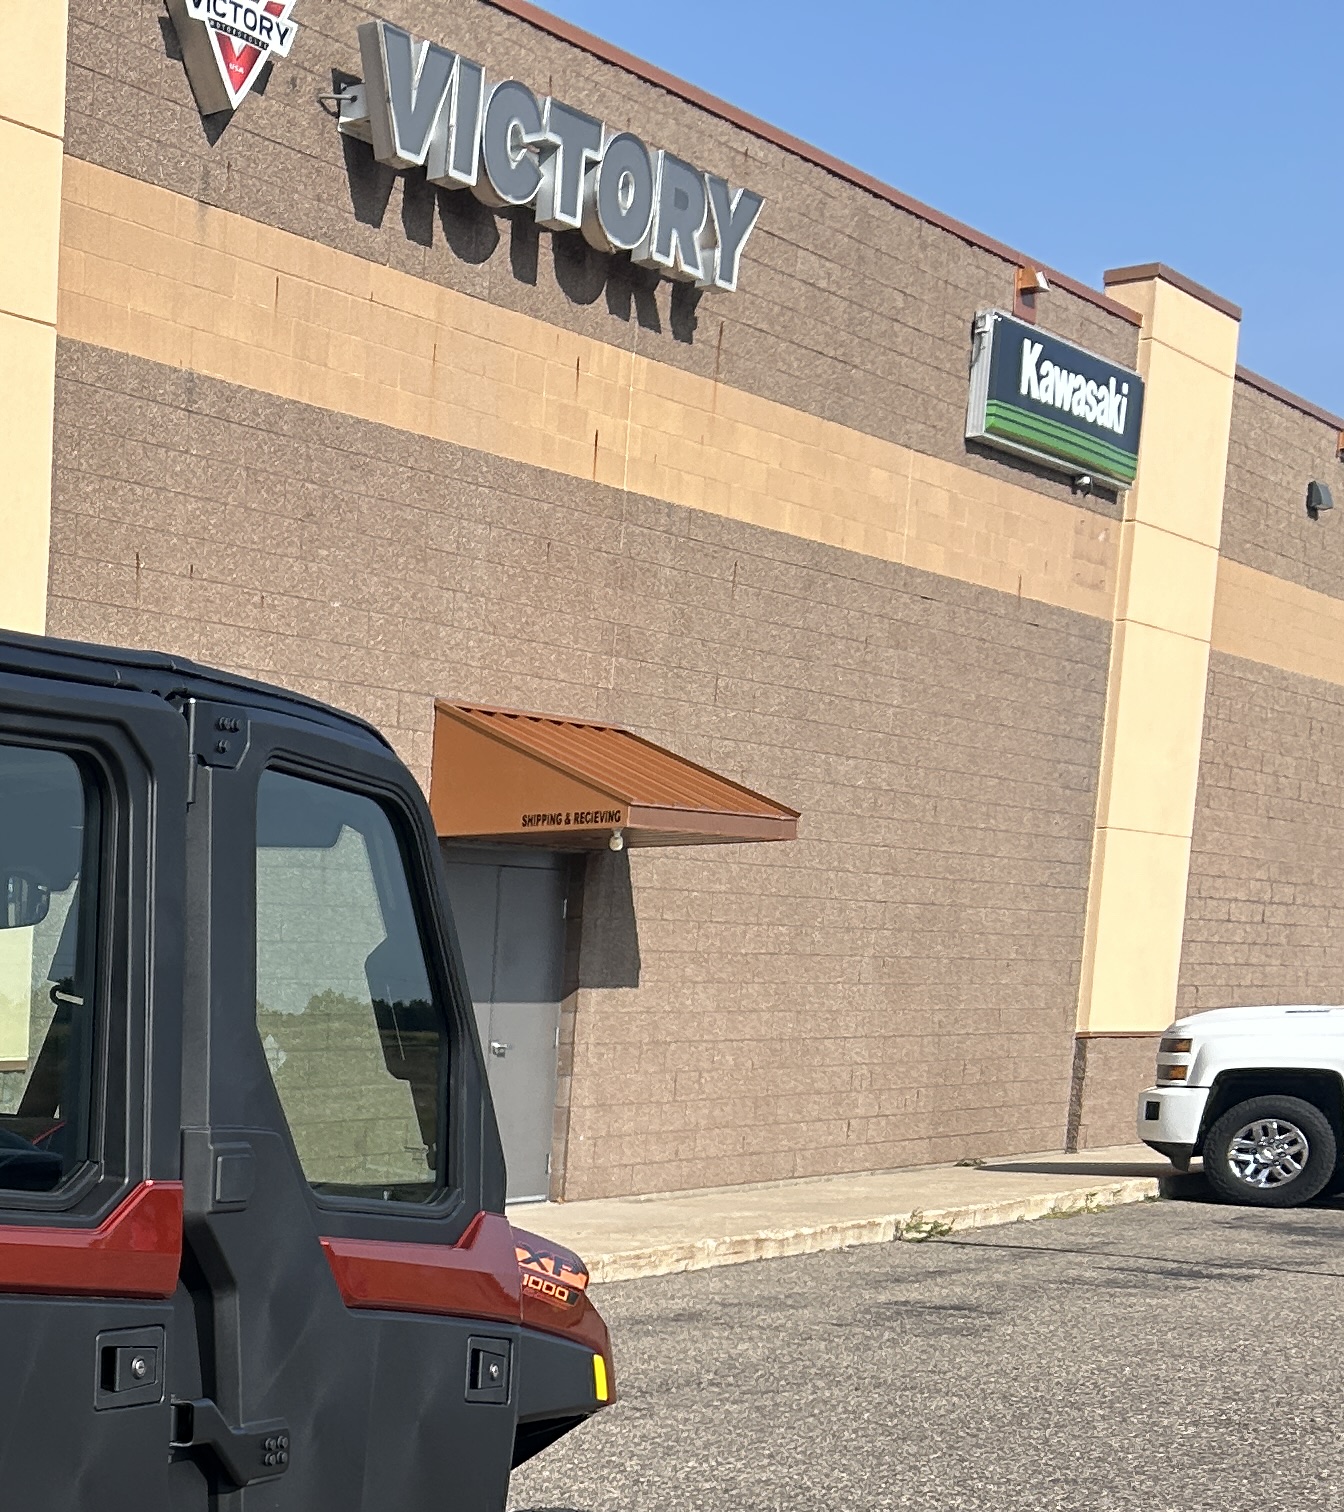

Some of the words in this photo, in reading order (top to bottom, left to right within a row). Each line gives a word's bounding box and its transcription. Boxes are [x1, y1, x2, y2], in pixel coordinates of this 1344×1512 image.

[358, 19, 764, 292] VICTORY
[1021, 338, 1128, 434] Kawasaki
[522, 812, 562, 827] SHIPPING
[564, 812, 571, 825] &
[574, 809, 621, 825] RECIEVING
[523, 1273, 568, 1302] 1000
